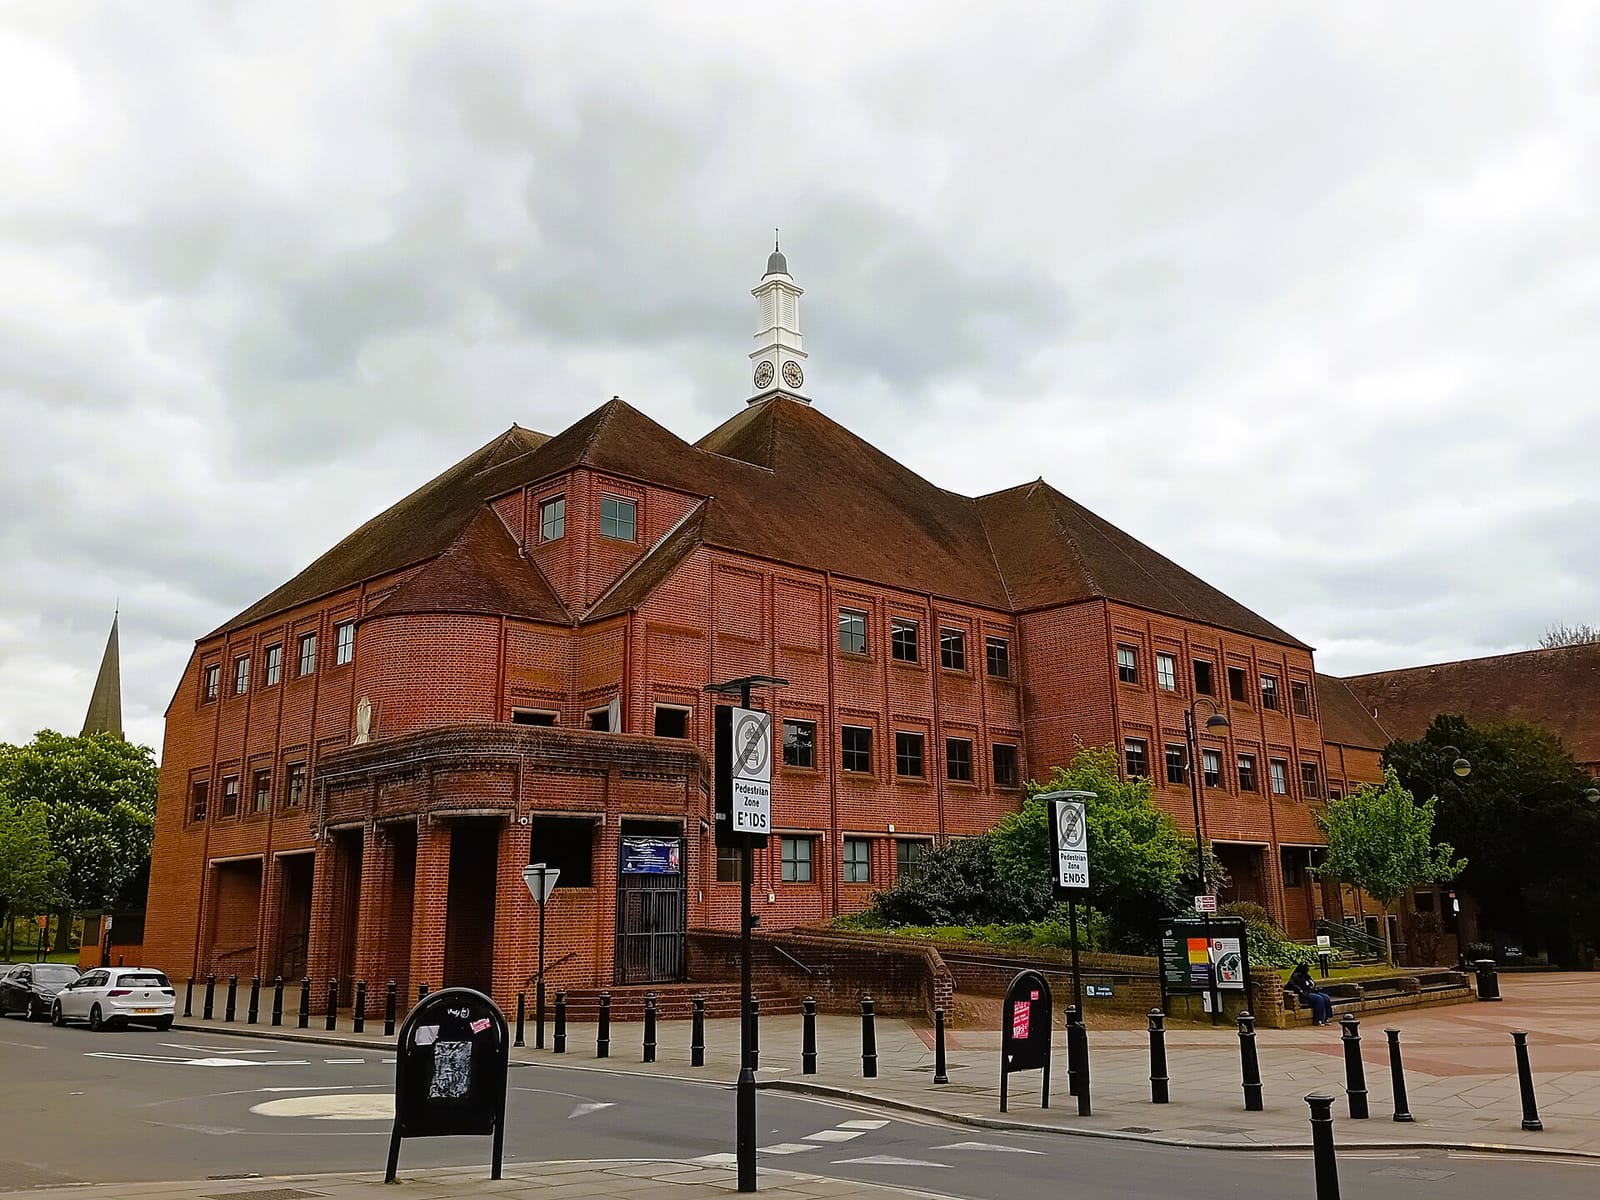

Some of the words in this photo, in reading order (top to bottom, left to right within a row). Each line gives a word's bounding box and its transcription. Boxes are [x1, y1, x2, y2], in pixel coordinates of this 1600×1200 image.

[735, 783, 769, 796] Pedestrian
[744, 797, 760, 807] Zone
[1063, 872, 1086, 883] ENDS
